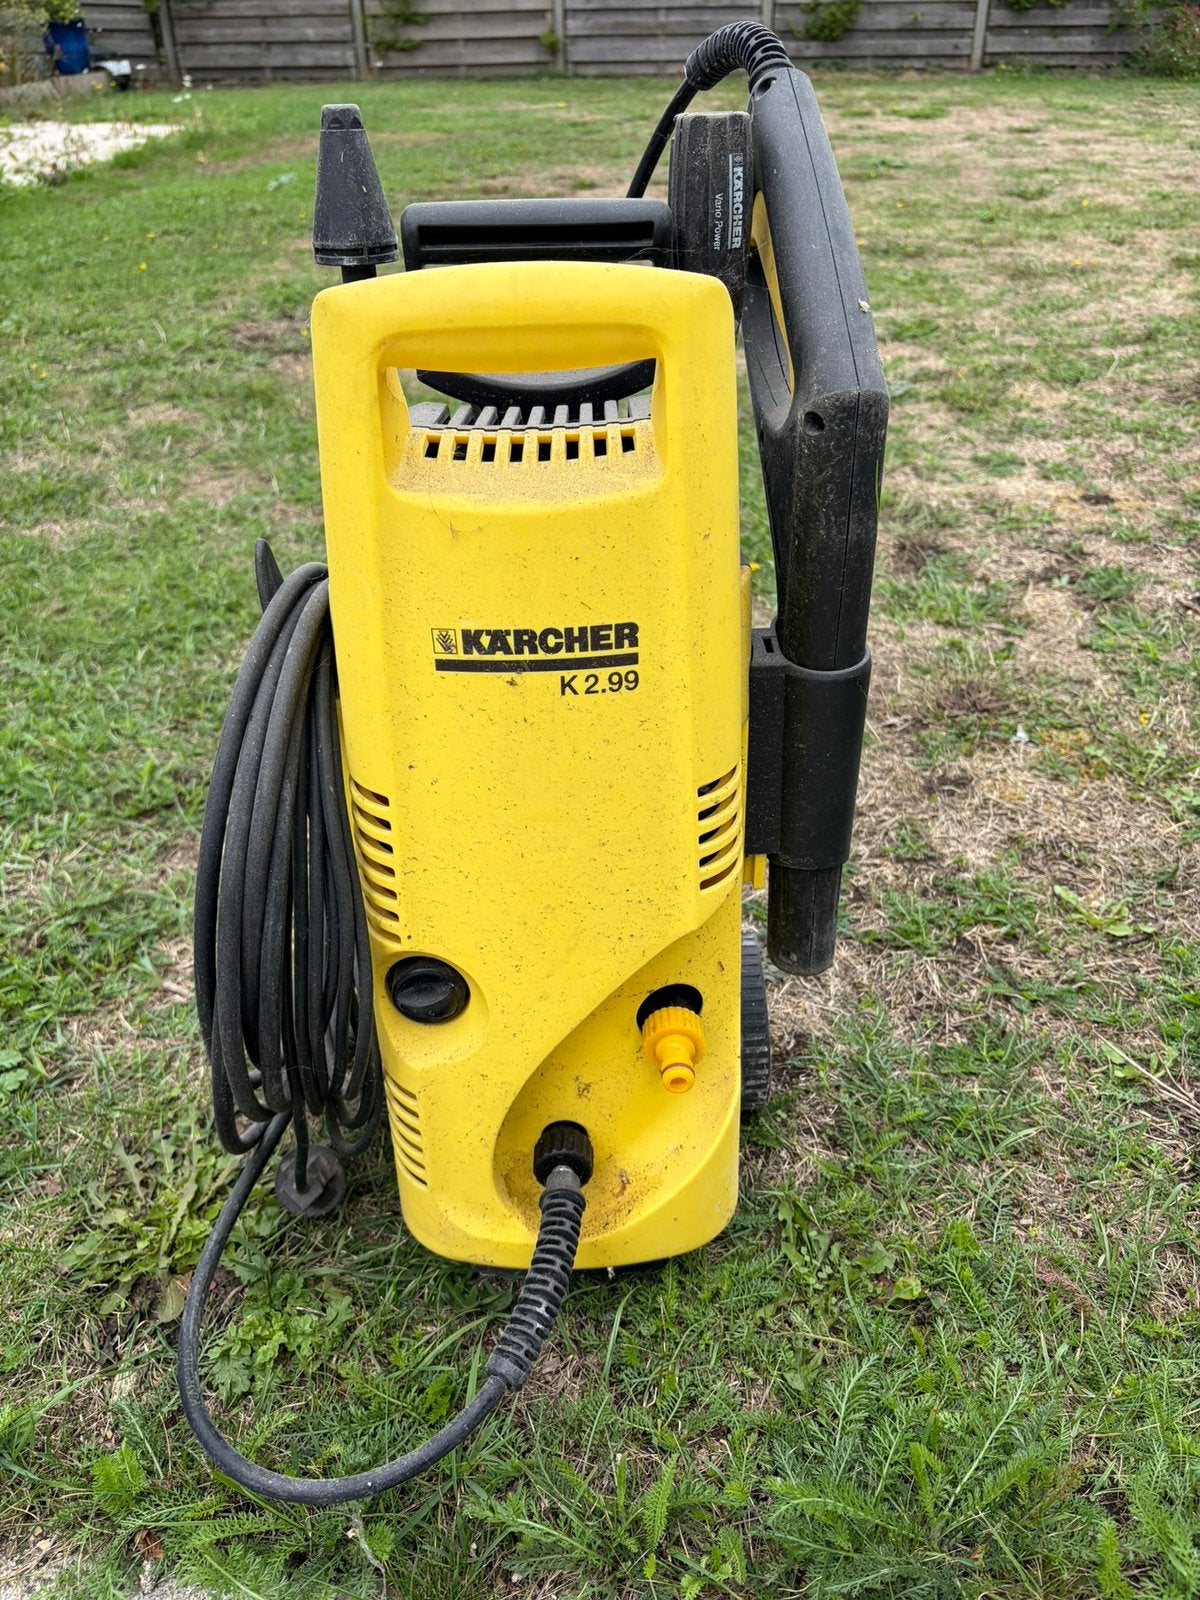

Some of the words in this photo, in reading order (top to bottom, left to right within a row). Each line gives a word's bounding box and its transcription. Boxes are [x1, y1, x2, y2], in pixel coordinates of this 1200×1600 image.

[715, 192, 724, 218] Vario
[714, 220, 723, 251] Power
[461, 622, 639, 655] KÄRCHER
[560, 675, 579, 696] K
[584, 669, 639, 694] 2.99
